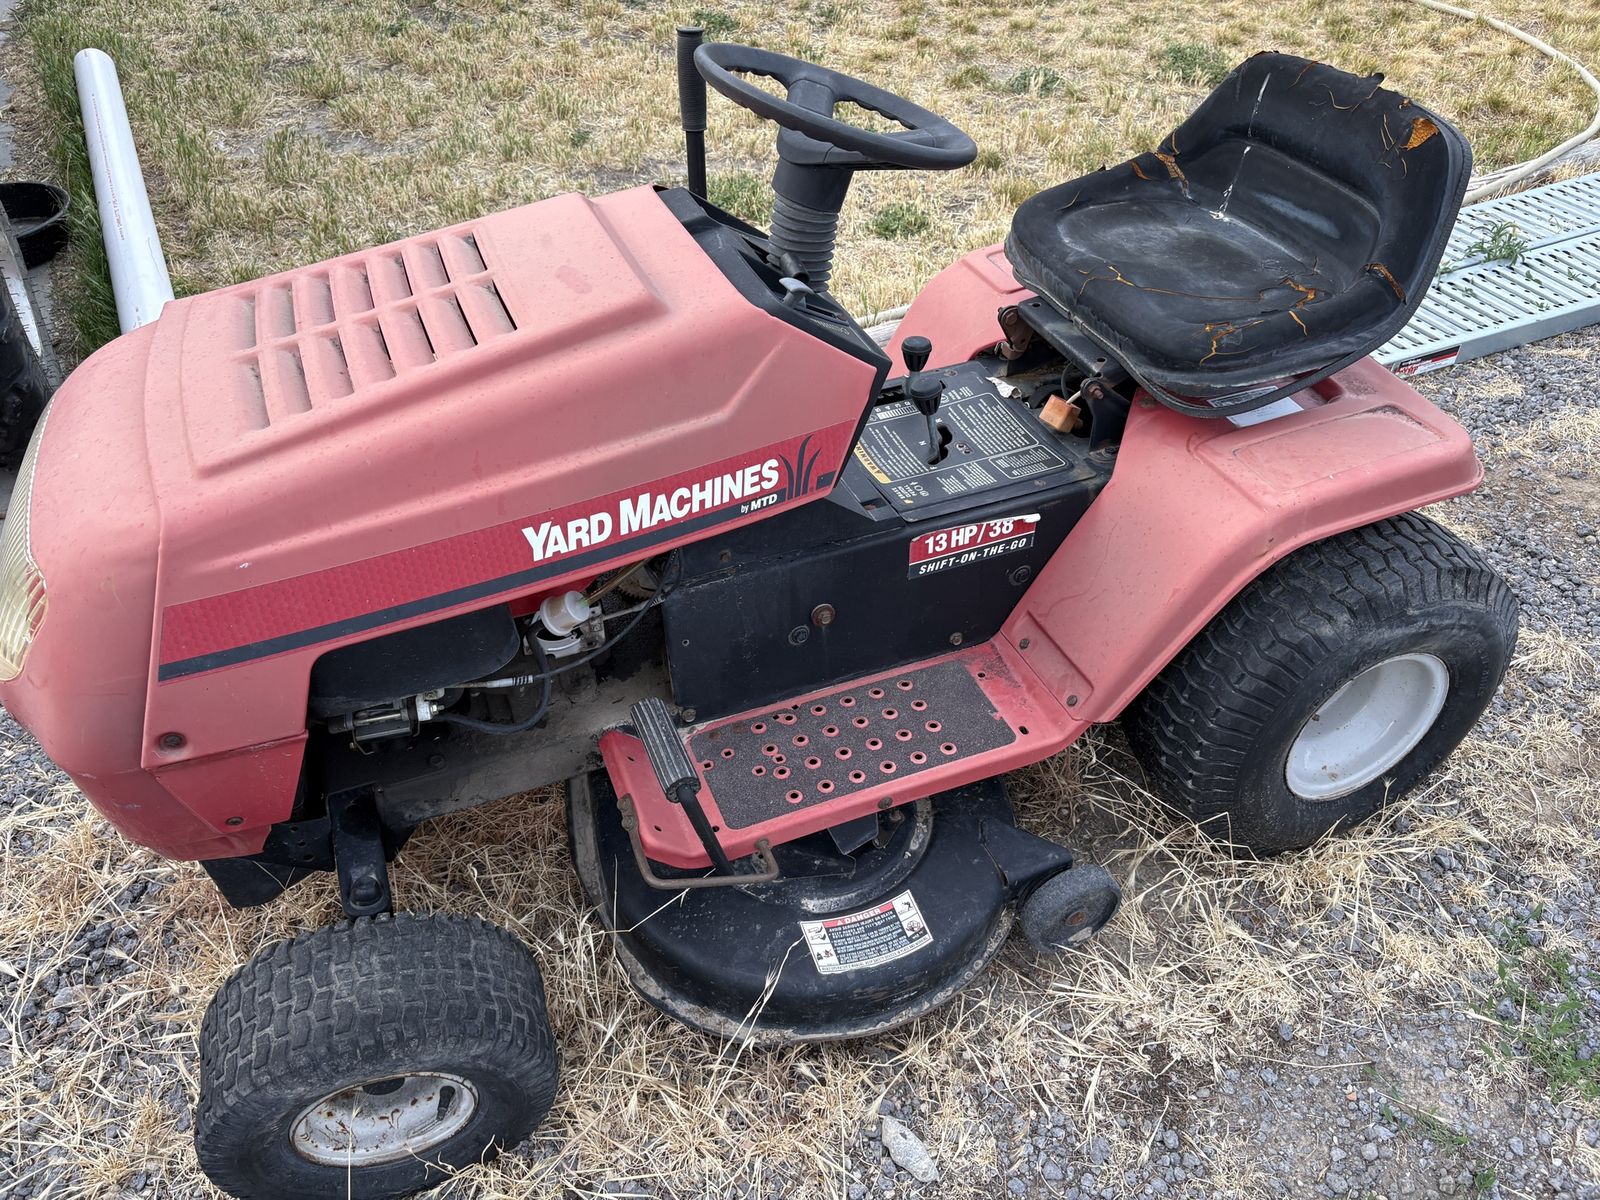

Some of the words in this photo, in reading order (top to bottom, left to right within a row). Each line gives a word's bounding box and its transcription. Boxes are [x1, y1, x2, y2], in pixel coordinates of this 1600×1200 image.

[874, 406, 882, 414] 5
[894, 402, 902, 410] 3
[934, 416, 942, 424] R
[918, 439, 926, 447] N
[856, 444, 876, 471] WARNIN
[522, 512, 612, 562] YARD
[619, 458, 780, 536] MACHINES
[740, 504, 750, 514] by
[750, 493, 778, 511] MTD
[924, 532, 948, 554] 13
[918, 538, 1026, 574] SHIFT-ON-THE-GO
[844, 908, 880, 924] DANGER
